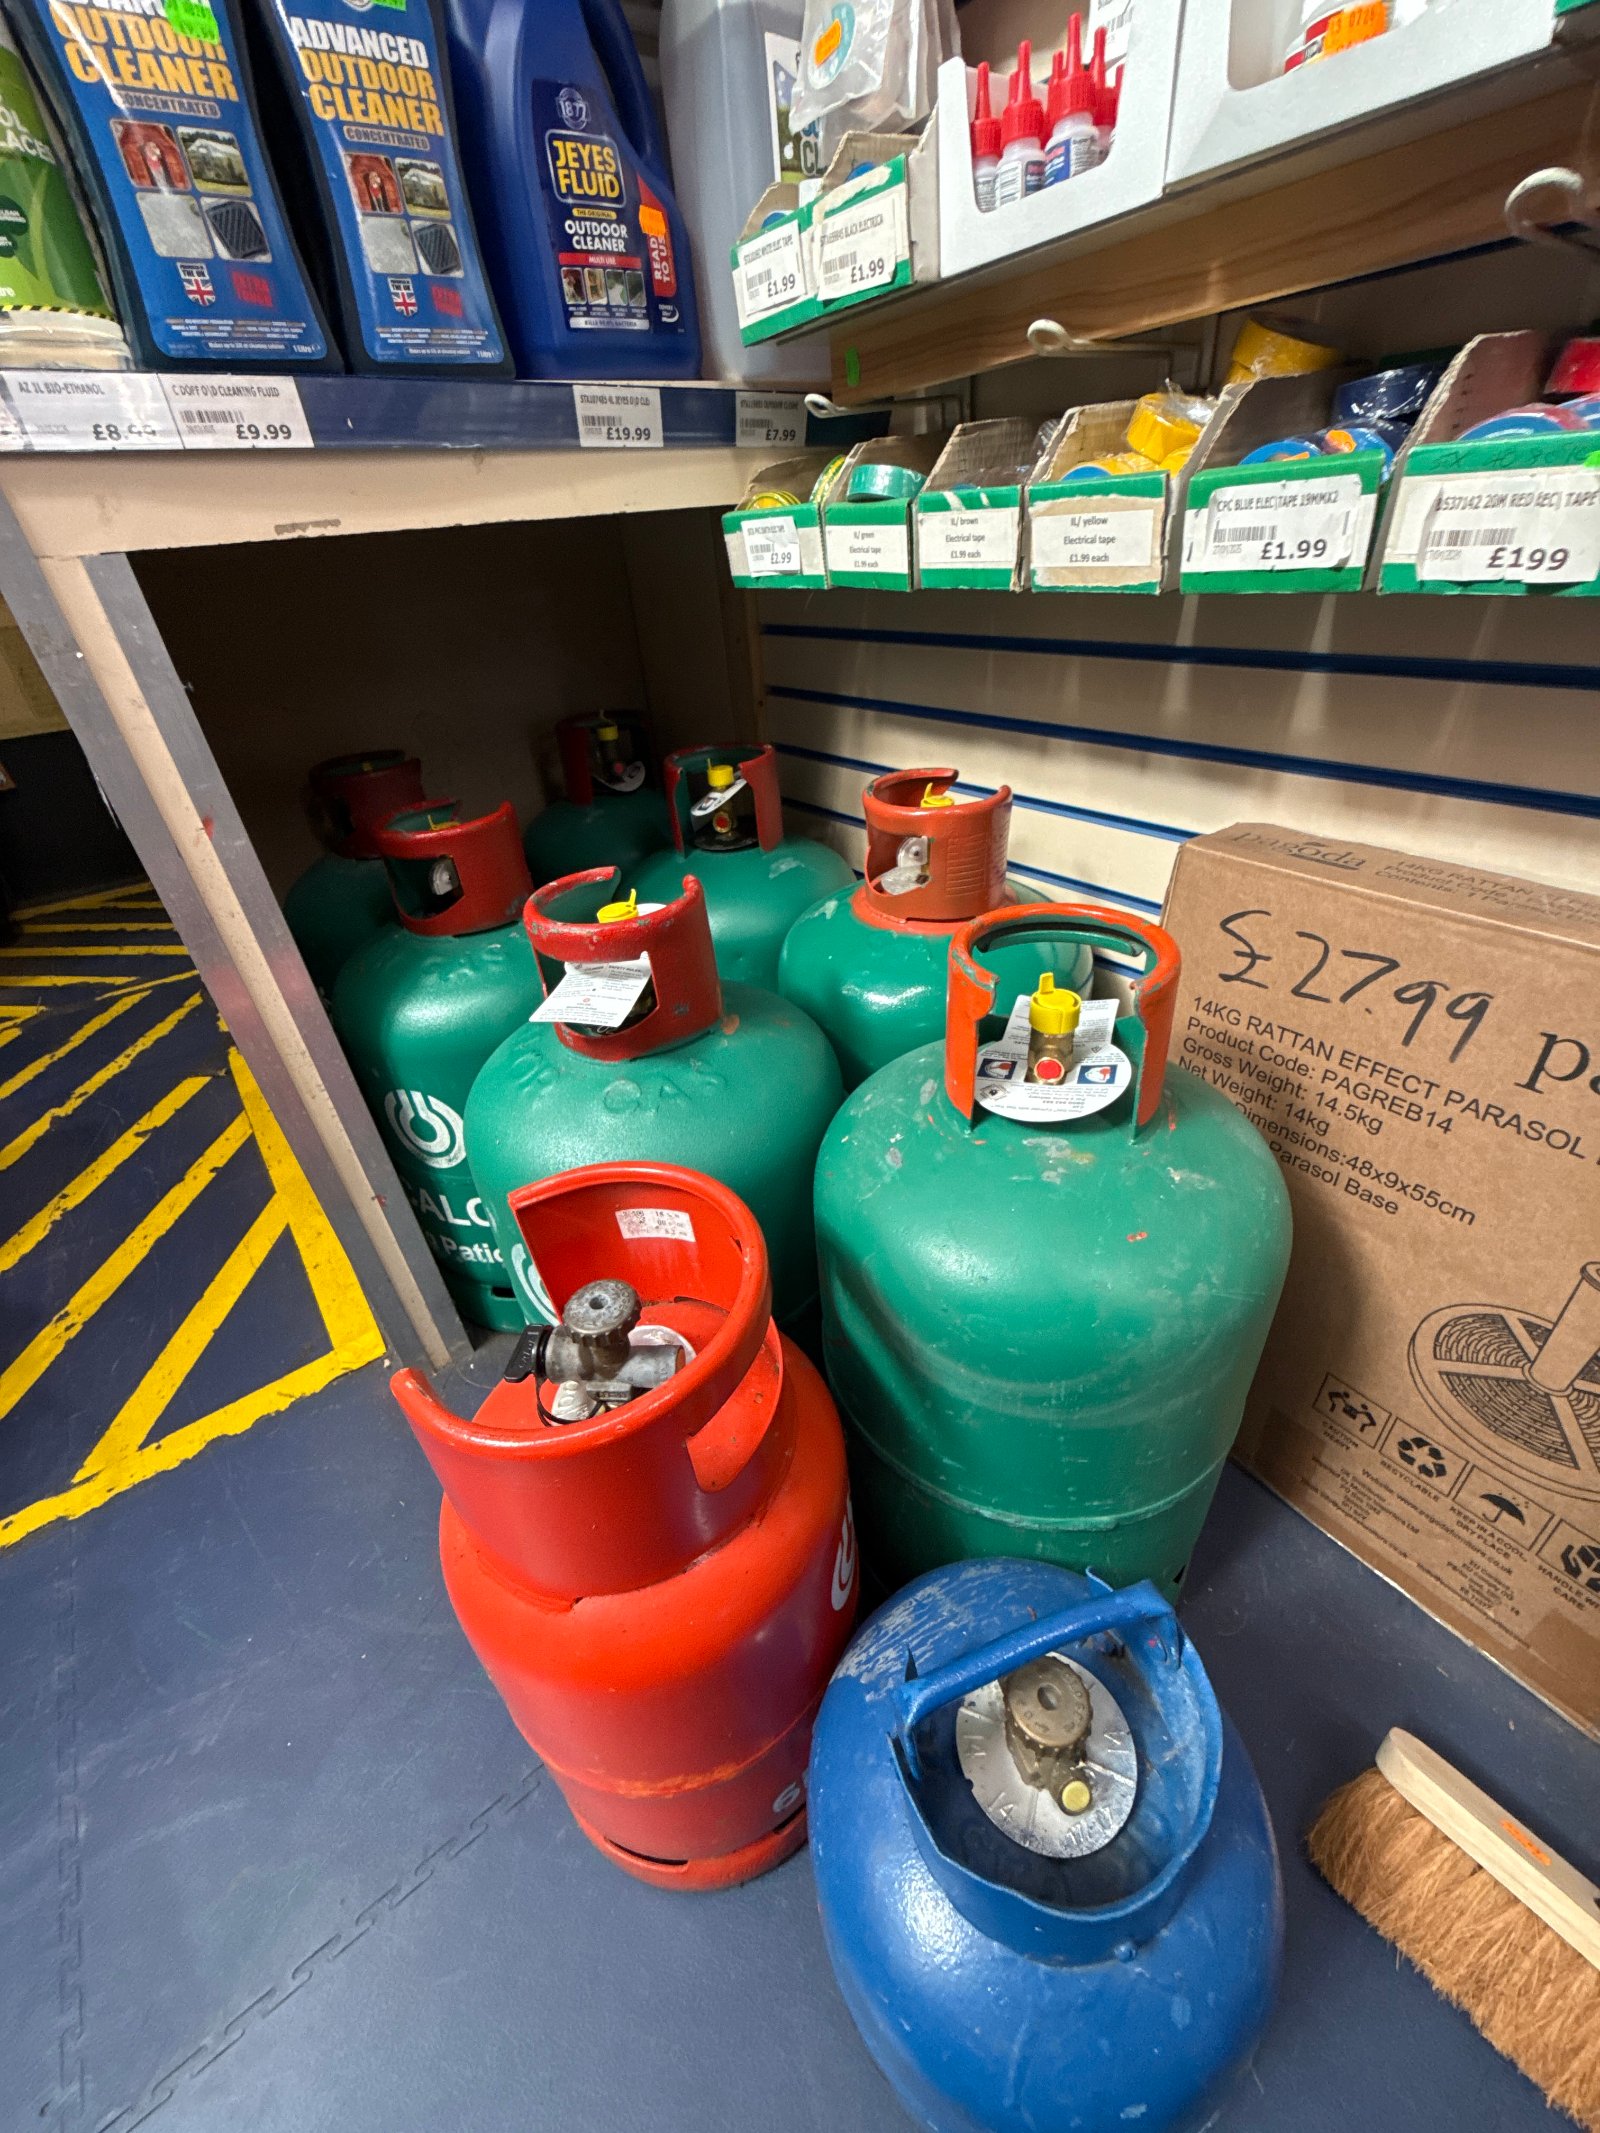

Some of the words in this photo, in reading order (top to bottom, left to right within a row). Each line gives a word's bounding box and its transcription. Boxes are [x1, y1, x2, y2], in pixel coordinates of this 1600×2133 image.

[290, 16, 429, 69] ADVANCED
[64, 40, 239, 102] CLEANER
[299, 47, 437, 101] OUTDOOR
[309, 83, 445, 137] CLEANER
[346, 127, 429, 150] CONCENTRATED
[552, 140, 617, 173] JEYES
[557, 168, 620, 198] FLUID
[588, 210, 613, 218] ORIGINAL
[564, 220, 628, 238] OUTDOOR
[572, 236, 626, 252] CLEANER
[659, 235, 668, 257] US
[649, 237, 662, 281] READ
[661, 262, 670, 282] TO
[851, 257, 885, 285] £1.99
[768, 273, 796, 298] £1.99
[44, 382, 104, 395] BIO-ETHANOL
[219, 386, 257, 398] CLEANING
[257, 387, 280, 398] FLUID
[236, 423, 292, 440] £9.99
[606, 426, 651, 441] £19.99
[765, 429, 797, 441] £7.99
[1216, 499, 1234, 513] CPC
[1234, 497, 1255, 511] BLUE
[1564, 490, 1600, 508] TAPE
[959, 516, 979, 526] brown
[1082, 515, 1109, 527] yellow
[861, 531, 876, 541] green
[945, 533, 971, 543] Electrical
[972, 533, 985, 544] tape
[1063, 534, 1097, 545] Electrical
[1098, 535, 1117, 545] tape
[770, 551, 792, 565] £2.99
[849, 545, 871, 554] Electrical
[871, 546, 882, 555] tape
[950, 550, 966, 559] £1.99
[967, 550, 982, 559] each
[1069, 553, 1091, 563] £1.99
[1091, 553, 1110, 563] each
[1260, 538, 1328, 561] £1.99
[867, 560, 879, 568] each
[1231, 832, 1366, 870] pagoda
[1383, 865, 1453, 885] Product
[1448, 872, 1534, 896] RATTAN
[1218, 909, 1495, 1064] £27.99
[1182, 1036, 1233, 1070] Gross
[1235, 1056, 1308, 1101] Weight:
[1314, 1090, 1385, 1136] 14.5kg
[1187, 1016, 1256, 1057] Product
[1258, 1042, 1315, 1080] Code:
[1320, 1067, 1454, 1136] PAGREB14
[1191, 995, 1242, 1028] 14KG
[1246, 1014, 1335, 1063] RATTAN
[1338, 1048, 1441, 1101] EFFECT
[1443, 1089, 1587, 1160] PARASOL
[1178, 1055, 1209, 1082] Net
[1210, 1067, 1277, 1112] Weight:
[1284, 1100, 1331, 1137] 14kg
[1343, 1176, 1400, 1217] Base
[1322, 1420, 1360, 1449] CAUTION
[1322, 1430, 1350, 1451] HEAVY
[1379, 1459, 1441, 1503] RECYCLABLE
[1449, 1506, 1476, 1527] KEEP
[1476, 1524, 1488, 1534] IN
[1488, 1531, 1496, 1540] A
[1455, 1519, 1476, 1537] DRY
[1477, 1533, 1512, 1560] PLACE
[1537, 1563, 1584, 1598] HANDLE
[1583, 1596, 1600, 1610] WI
[1552, 1585, 1586, 1612] CARE
